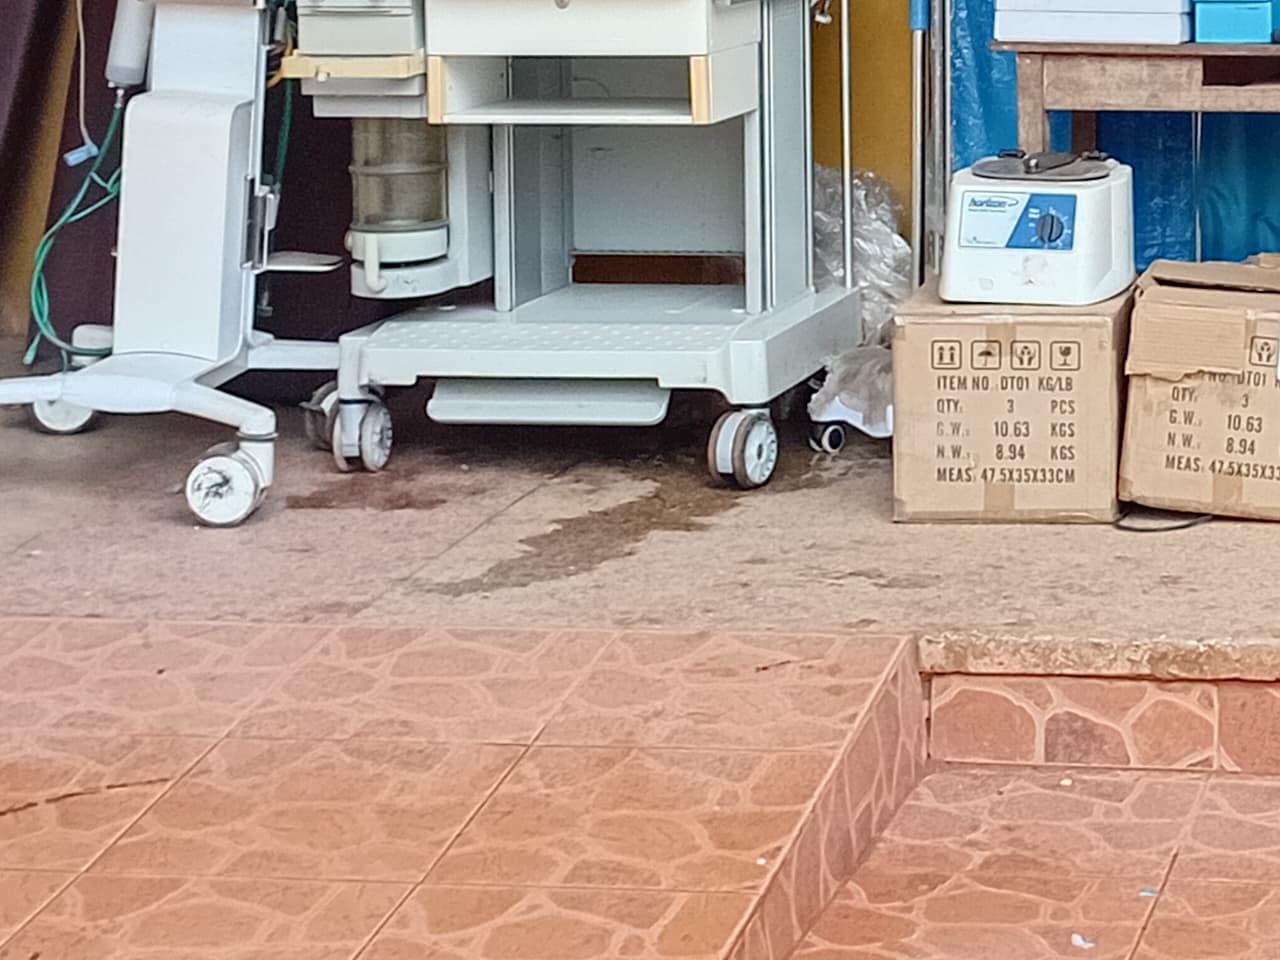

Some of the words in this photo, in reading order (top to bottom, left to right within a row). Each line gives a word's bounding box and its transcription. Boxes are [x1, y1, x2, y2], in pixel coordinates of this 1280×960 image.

[936, 375, 968, 391] ITEM
[1038, 376, 1073, 392] KG/LB
[1007, 399, 1014, 414] 3
[1050, 399, 1076, 415] PCS
[1241, 393, 1249, 409] 3
[994, 421, 1030, 438] 10.63
[1050, 422, 1076, 438] KGS
[1227, 414, 1263, 434] 10.63
[995, 444, 1026, 461] 8.94
[1050, 445, 1076, 461] KGS
[1225, 437, 1256, 456] 8.94
[980, 467, 1076, 484] 47.5X35X33CM
